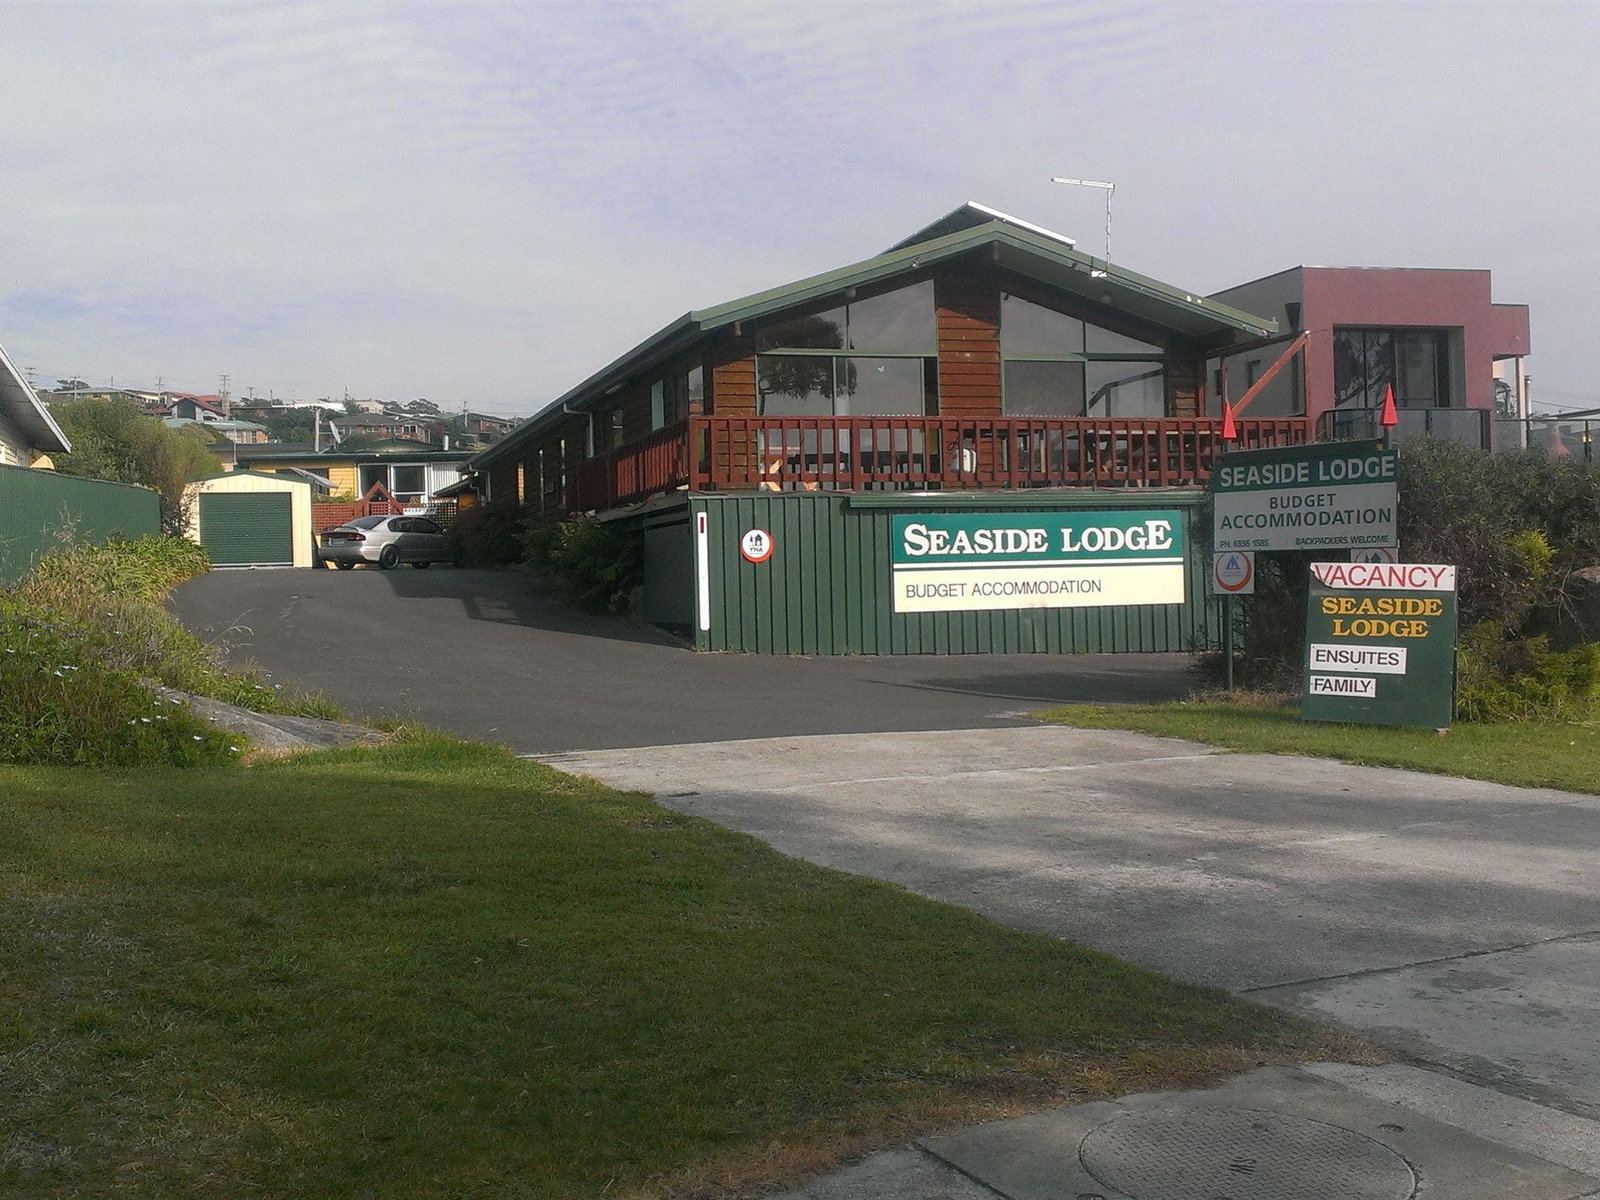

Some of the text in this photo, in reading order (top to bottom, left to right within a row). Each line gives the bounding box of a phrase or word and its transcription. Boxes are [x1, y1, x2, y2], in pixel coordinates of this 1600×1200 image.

[1219, 455, 1395, 487] SEASIDE LODGE
[1269, 493, 1336, 509] BUDGET
[1220, 507, 1391, 530] ACCOMMODATION
[903, 520, 1173, 556] SEASIDE LODGE
[1295, 534, 1389, 546] BACKPACKERS WELCOME
[1314, 564, 1447, 588] VACANCY
[905, 579, 1102, 598] BUDGET ACCOMMODATION
[1321, 597, 1443, 616] SEASIDE
[1332, 619, 1429, 637] LODGE
[1315, 649, 1400, 666] ENSUITES
[1314, 678, 1372, 693] FAMILY
